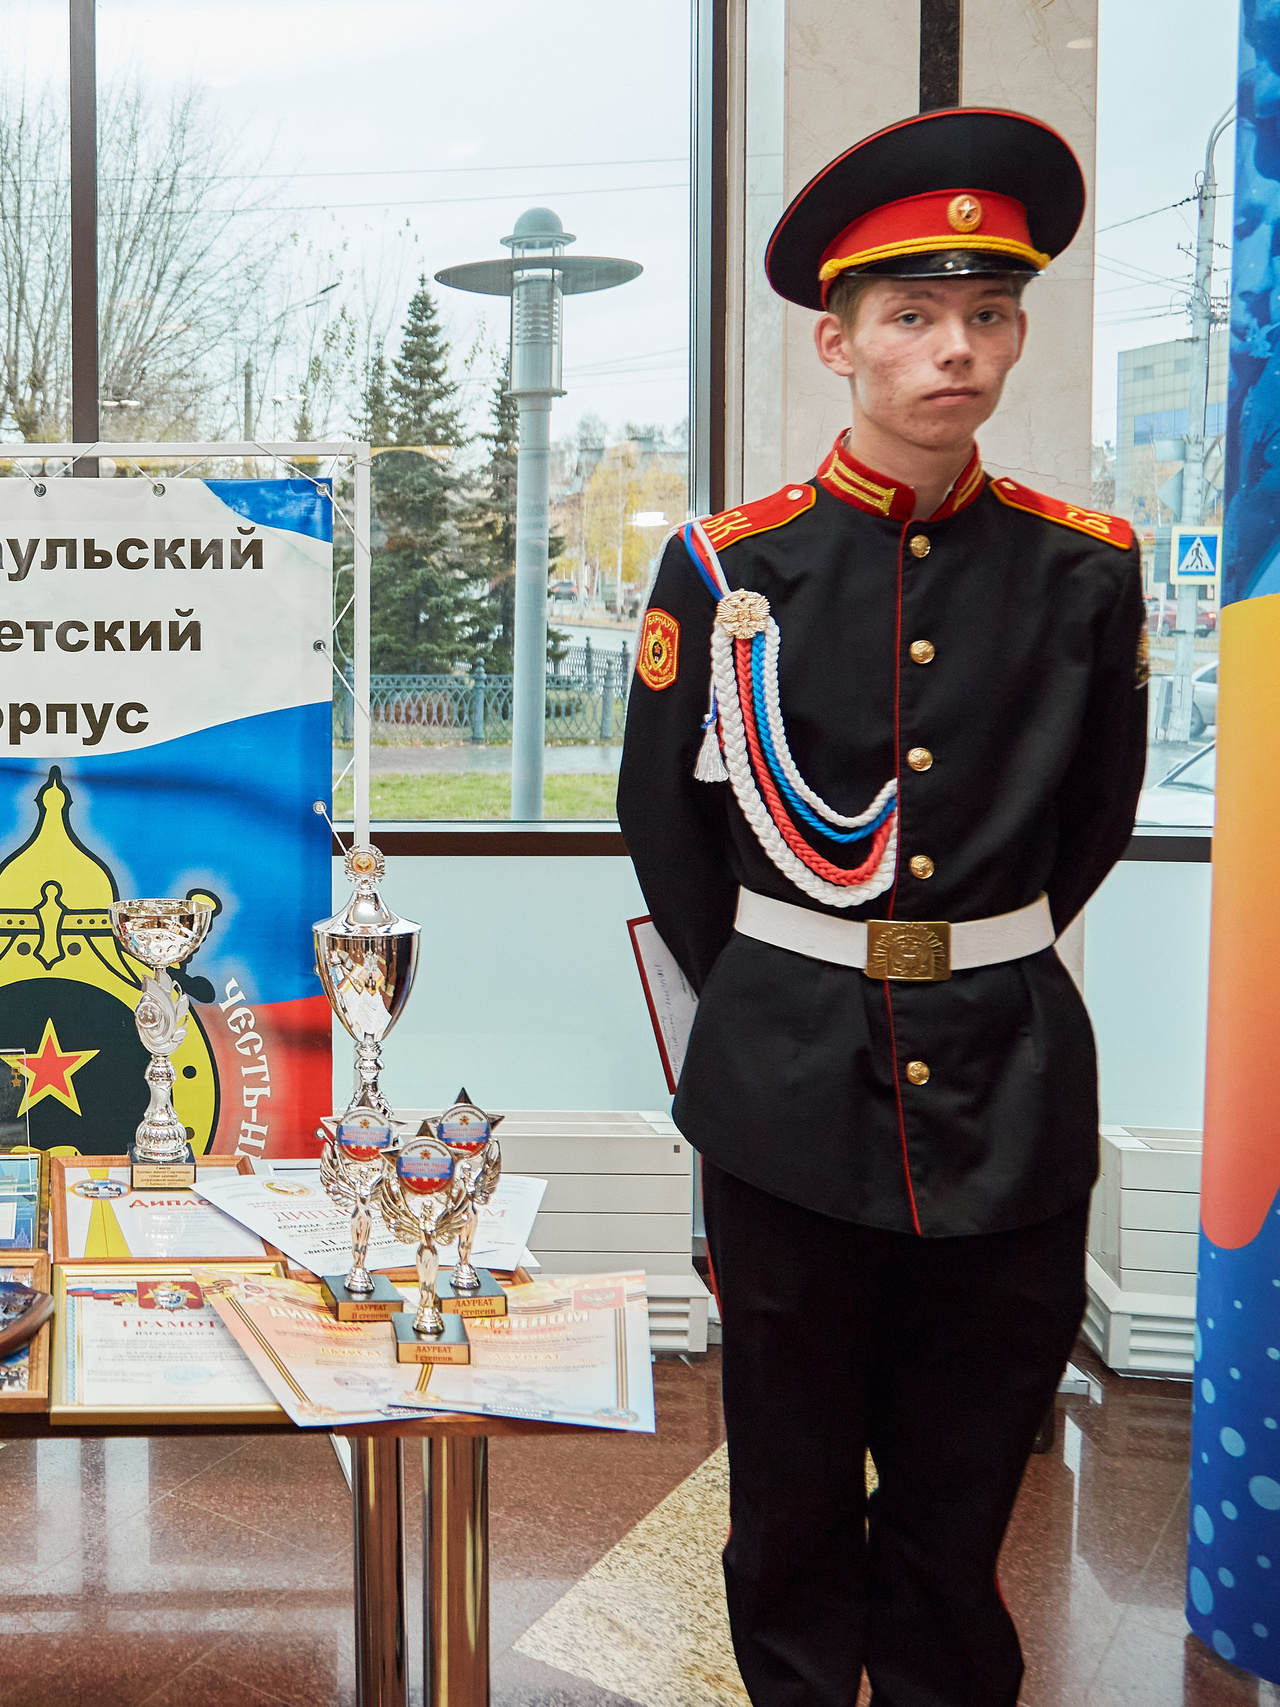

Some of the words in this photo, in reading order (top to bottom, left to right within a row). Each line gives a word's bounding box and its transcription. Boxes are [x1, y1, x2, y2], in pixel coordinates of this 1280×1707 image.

[702, 511, 752, 542] БК
[454, 1299, 494, 1307] ЛАУРЕАТ
[268, 1306, 367, 1326] ДИПЛ
[461, 1308, 496, 1316] степени
[471, 1310, 590, 1330] ДИПЛОМ
[415, 1346, 453, 1354] ЛАУРЕАТ
